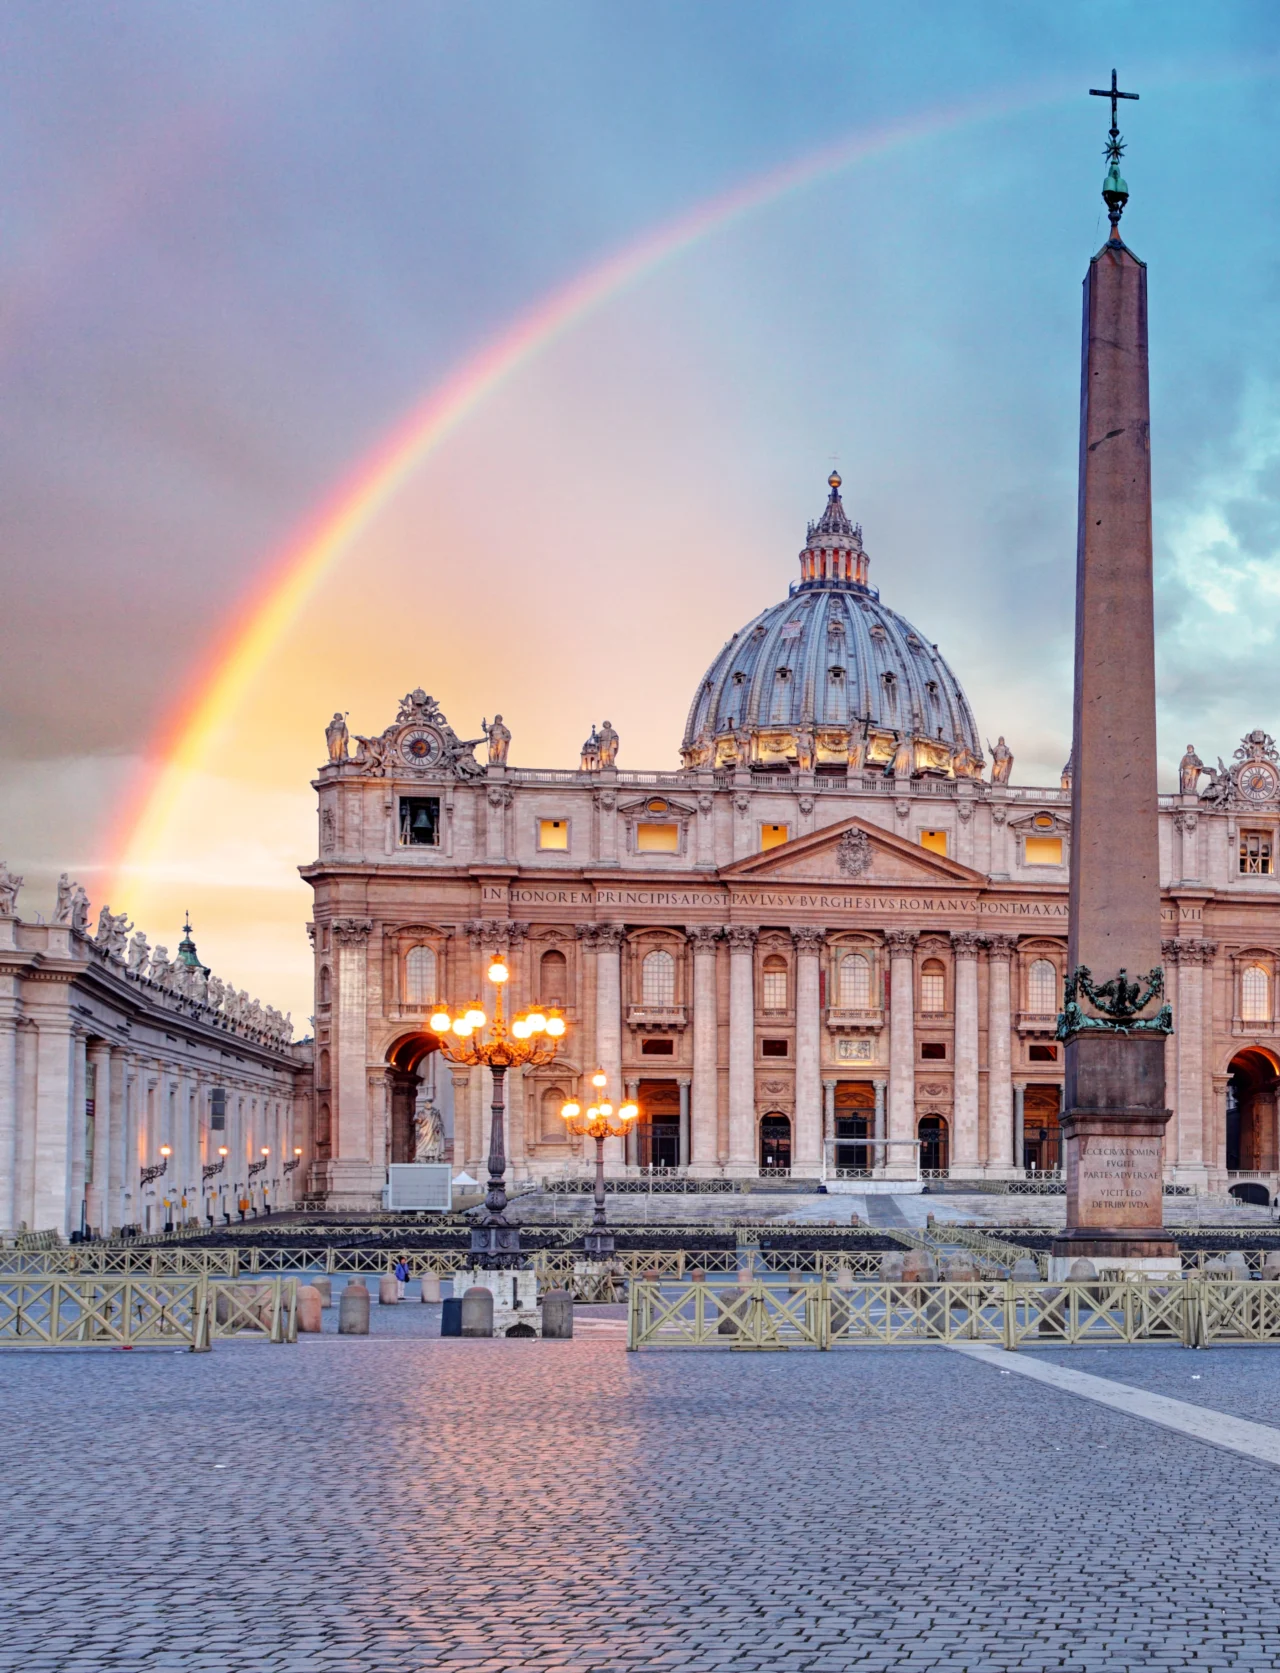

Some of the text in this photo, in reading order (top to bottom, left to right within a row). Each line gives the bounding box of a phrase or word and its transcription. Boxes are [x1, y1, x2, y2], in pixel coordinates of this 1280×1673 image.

[484, 888, 502, 899] IN
[511, 891, 593, 904] HONOREM
[597, 892, 678, 905] PRINCIPIS
[681, 894, 729, 906] APOST
[732, 893, 784, 906] PAVLVS
[800, 896, 895, 910] BVRGHESIVS
[900, 899, 976, 911] ROMANVS
[1182, 909, 1202, 920] VII
[1107, 1160, 1136, 1168] FVGITE
[1084, 1171, 1159, 1180] PARTES ADVERSAE
[1100, 1189, 1142, 1197] VICIT LEO
[1092, 1201, 1150, 1209] DE TRIBV IVDA
